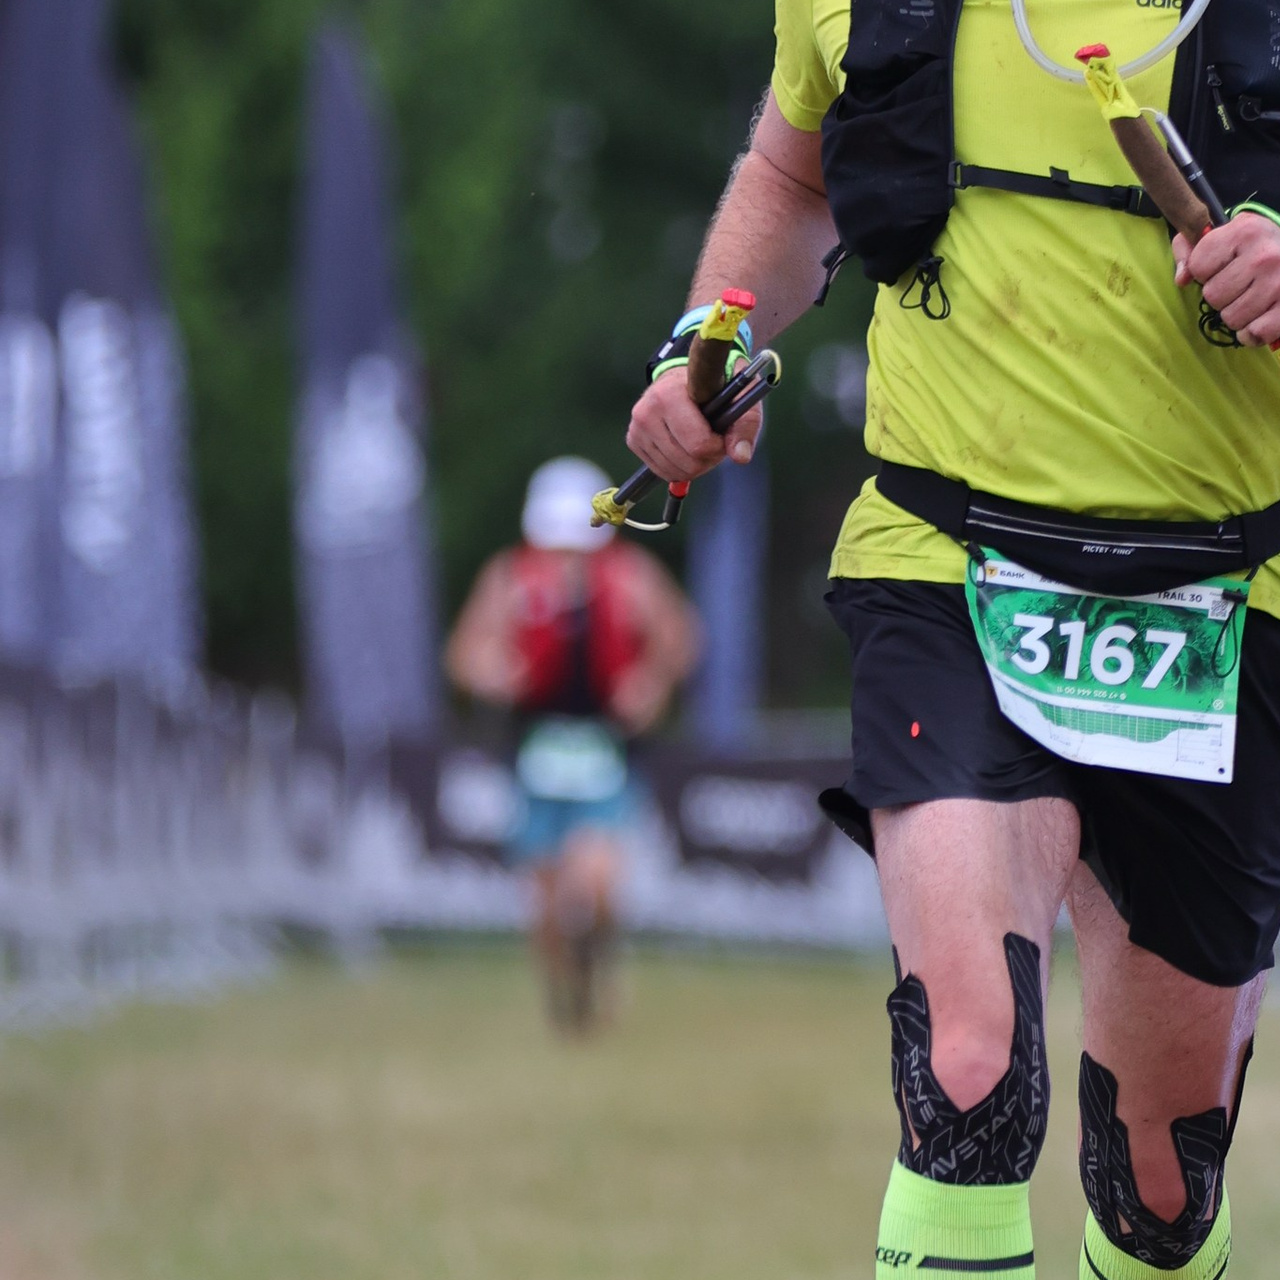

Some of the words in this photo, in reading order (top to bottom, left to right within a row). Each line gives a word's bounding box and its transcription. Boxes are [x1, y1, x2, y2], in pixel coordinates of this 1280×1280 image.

[1000, 570, 1025, 579] БАНК
[1188, 593, 1203, 603] 30
[1010, 613, 1187, 689] 3167
[1064, 686, 1076, 694] 00
[875, 1245, 912, 1269] cep
